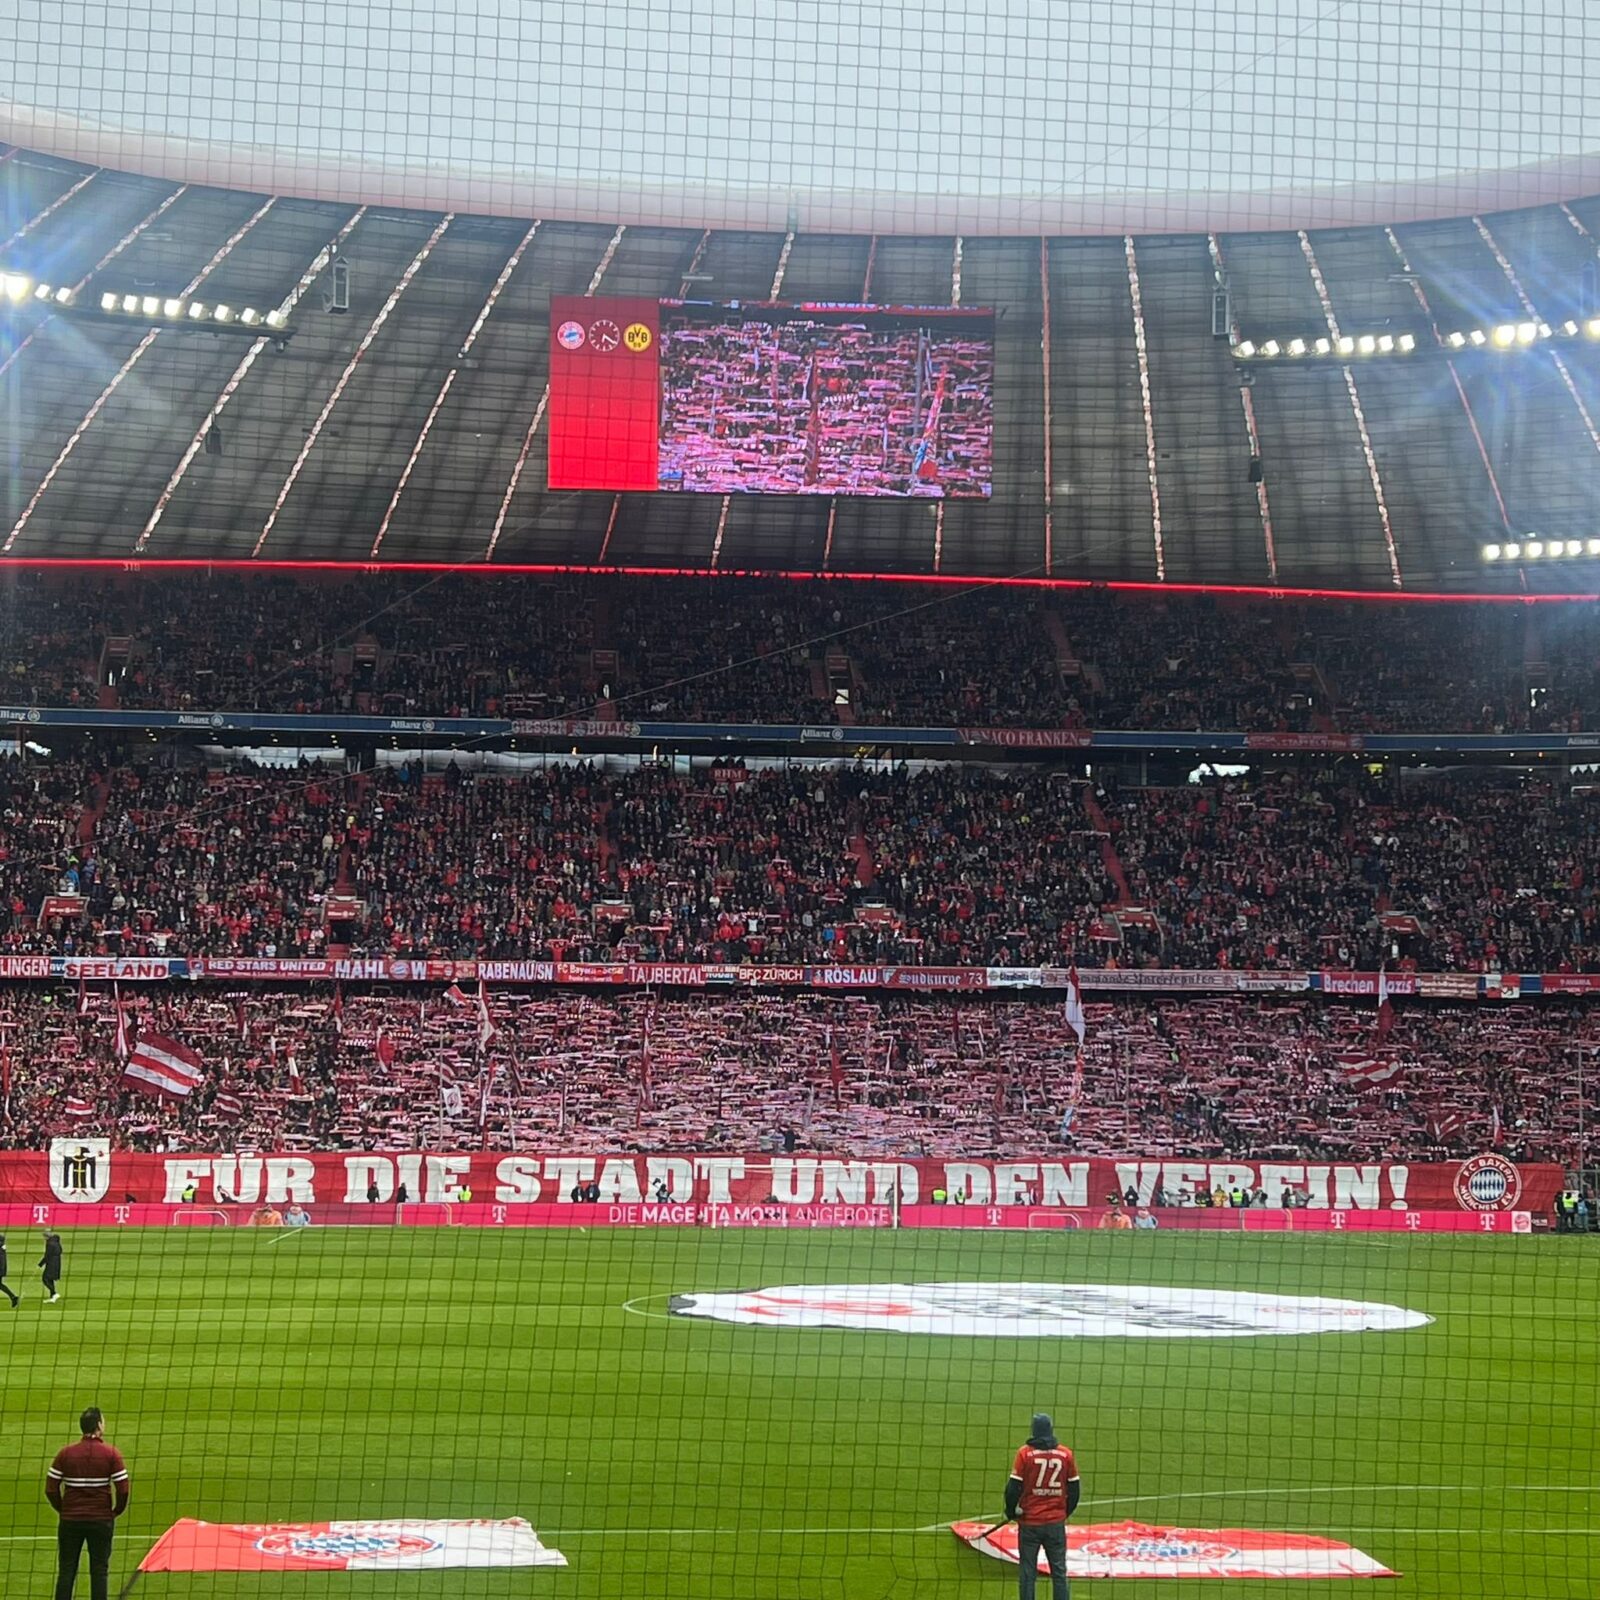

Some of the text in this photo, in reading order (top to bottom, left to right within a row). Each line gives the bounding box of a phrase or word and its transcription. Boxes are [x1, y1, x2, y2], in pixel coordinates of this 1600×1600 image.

[628, 326, 648, 342] BVB
[0, 710, 26, 720] llianz
[178, 715, 210, 724] Allianz
[390, 720, 421, 729] Allianz
[511, 720, 631, 736] GIESSEN BULLS
[800, 729, 831, 738] Allianz
[1019, 731, 1079, 746] FRANKEN
[66, 963, 167, 978] SEELAND
[208, 960, 326, 971] RED STARS UNITED
[478, 962, 553, 981] RABENAU/SN
[557, 963, 568, 974] FC
[629, 965, 705, 984] TAUBERTAL
[740, 968, 762, 980] BFC
[762, 967, 803, 981] ZÜRICH
[824, 966, 877, 984] RÖSLAU
[1324, 975, 1374, 993] Brechen
[1385, 976, 1412, 993] azis
[1478, 1159, 1515, 1183] BAYERN
[163, 1153, 1408, 1210] FÜR DIE STADT UND DEN VEREIN!
[33, 1205, 49, 1224] T
[114, 1205, 130, 1224] T
[491, 1205, 507, 1224] T
[609, 1206, 637, 1223] DIE
[986, 1207, 1001, 1225] T
[1330, 1211, 1345, 1230] T
[1405, 1212, 1421, 1231] T
[1480, 1213, 1495, 1231] T
[1034, 1457, 1062, 1487] 72
